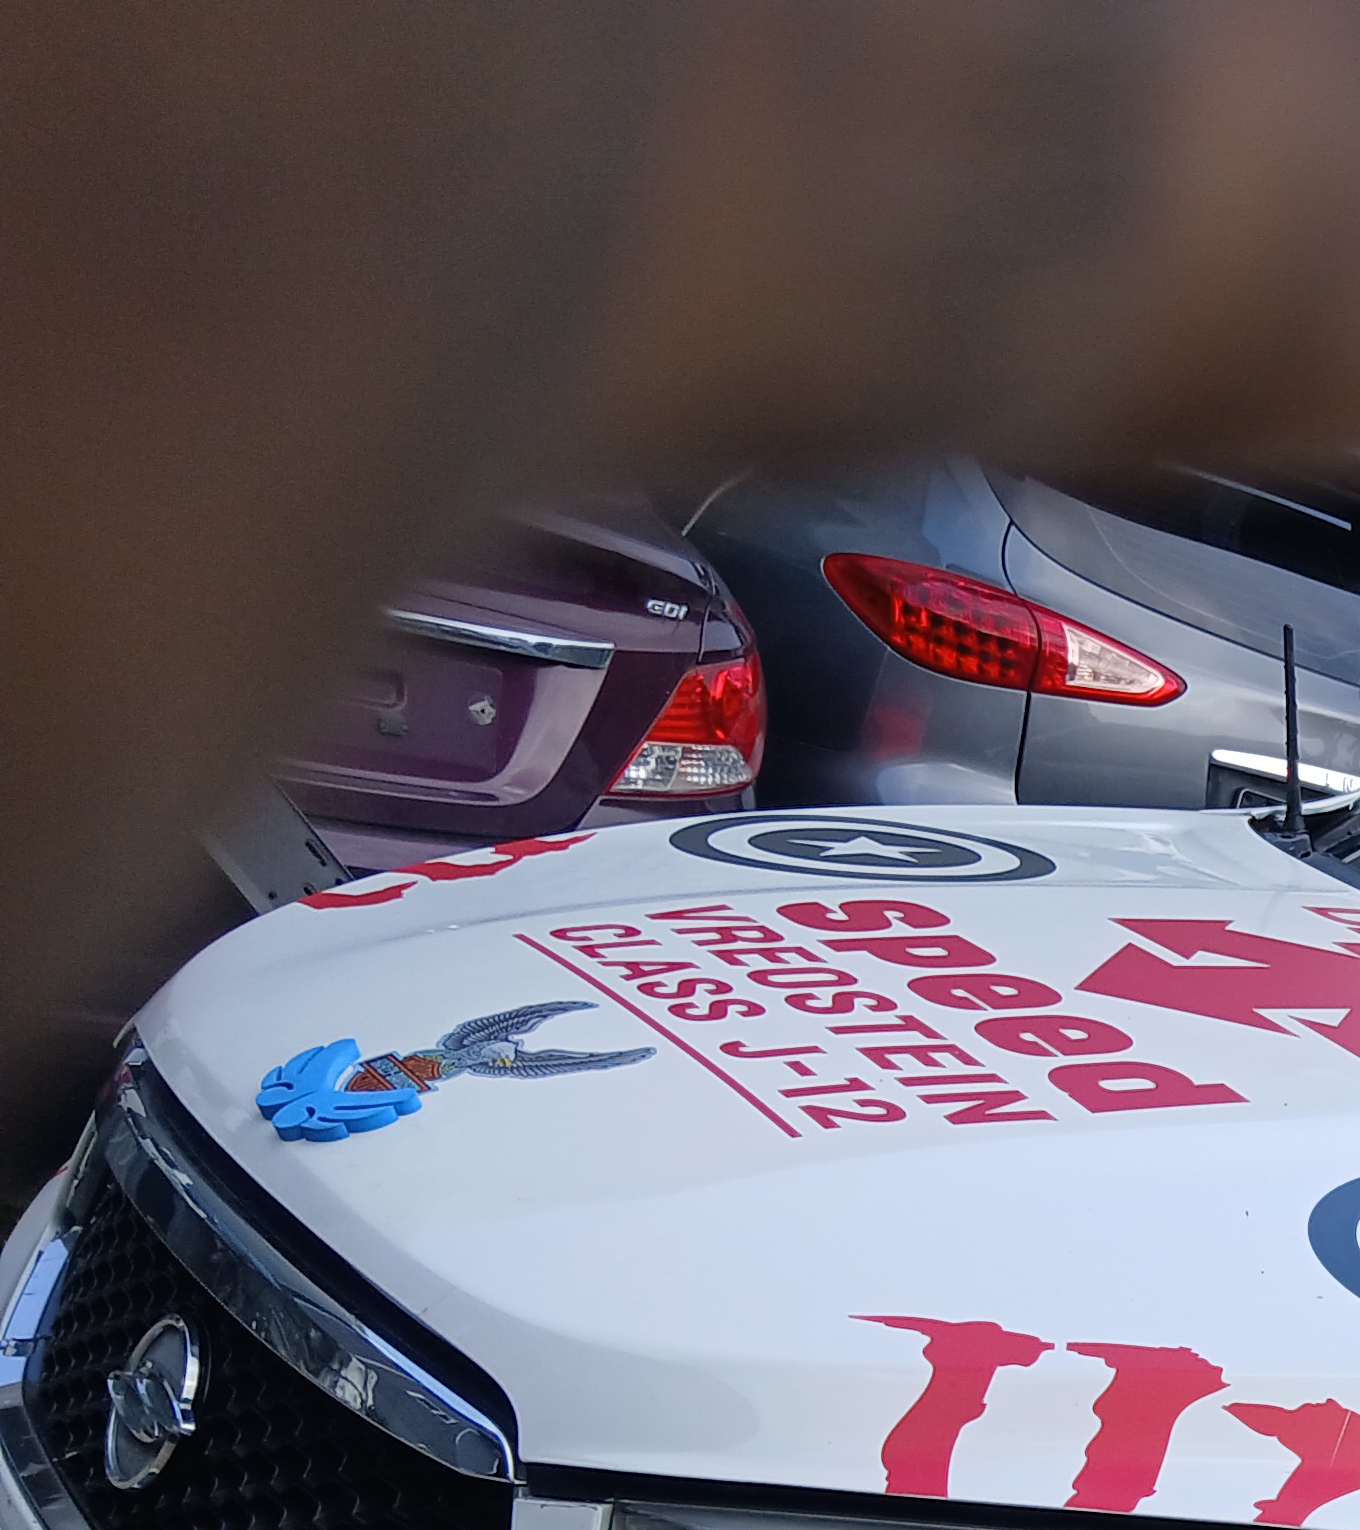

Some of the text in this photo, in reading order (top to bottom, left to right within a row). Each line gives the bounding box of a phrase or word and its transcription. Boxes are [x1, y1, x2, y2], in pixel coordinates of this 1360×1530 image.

[645, 599, 689, 620] GDI
[549, 923, 907, 1130] CLASS J-12
